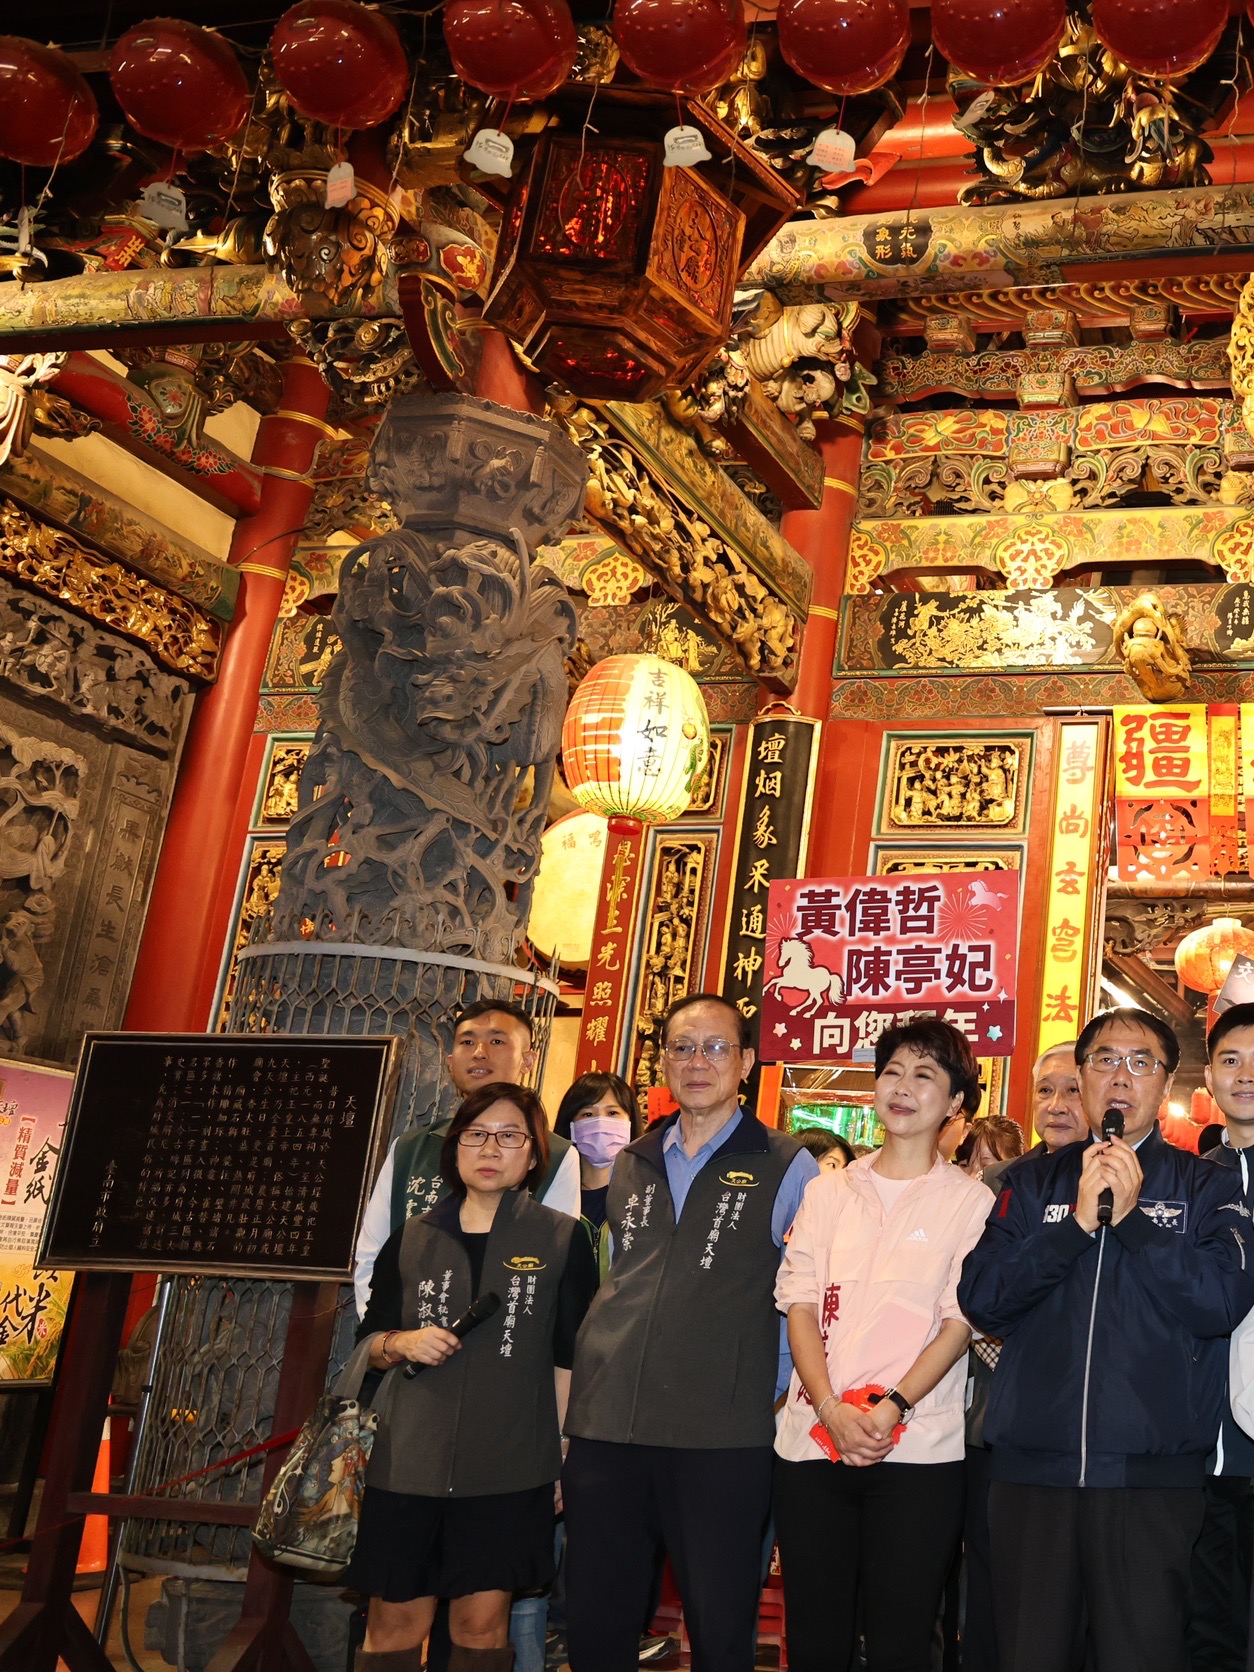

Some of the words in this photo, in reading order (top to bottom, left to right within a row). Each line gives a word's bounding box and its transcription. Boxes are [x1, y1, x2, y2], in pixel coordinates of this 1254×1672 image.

[637, 668, 669, 777] 吉祥如意
[796, 884, 941, 940] 黃偉哲
[846, 943, 994, 997] 陳亭妃
[339, 1095, 357, 1128] 天壇
[640, 1183, 656, 1228] 副董事長
[700, 1190, 732, 1270] 台灣首廟天壇
[727, 1191, 747, 1231] 財團法人
[500, 1274, 521, 1357] 台灣首廟天壇
[522, 1275, 537, 1315] 財團法人
